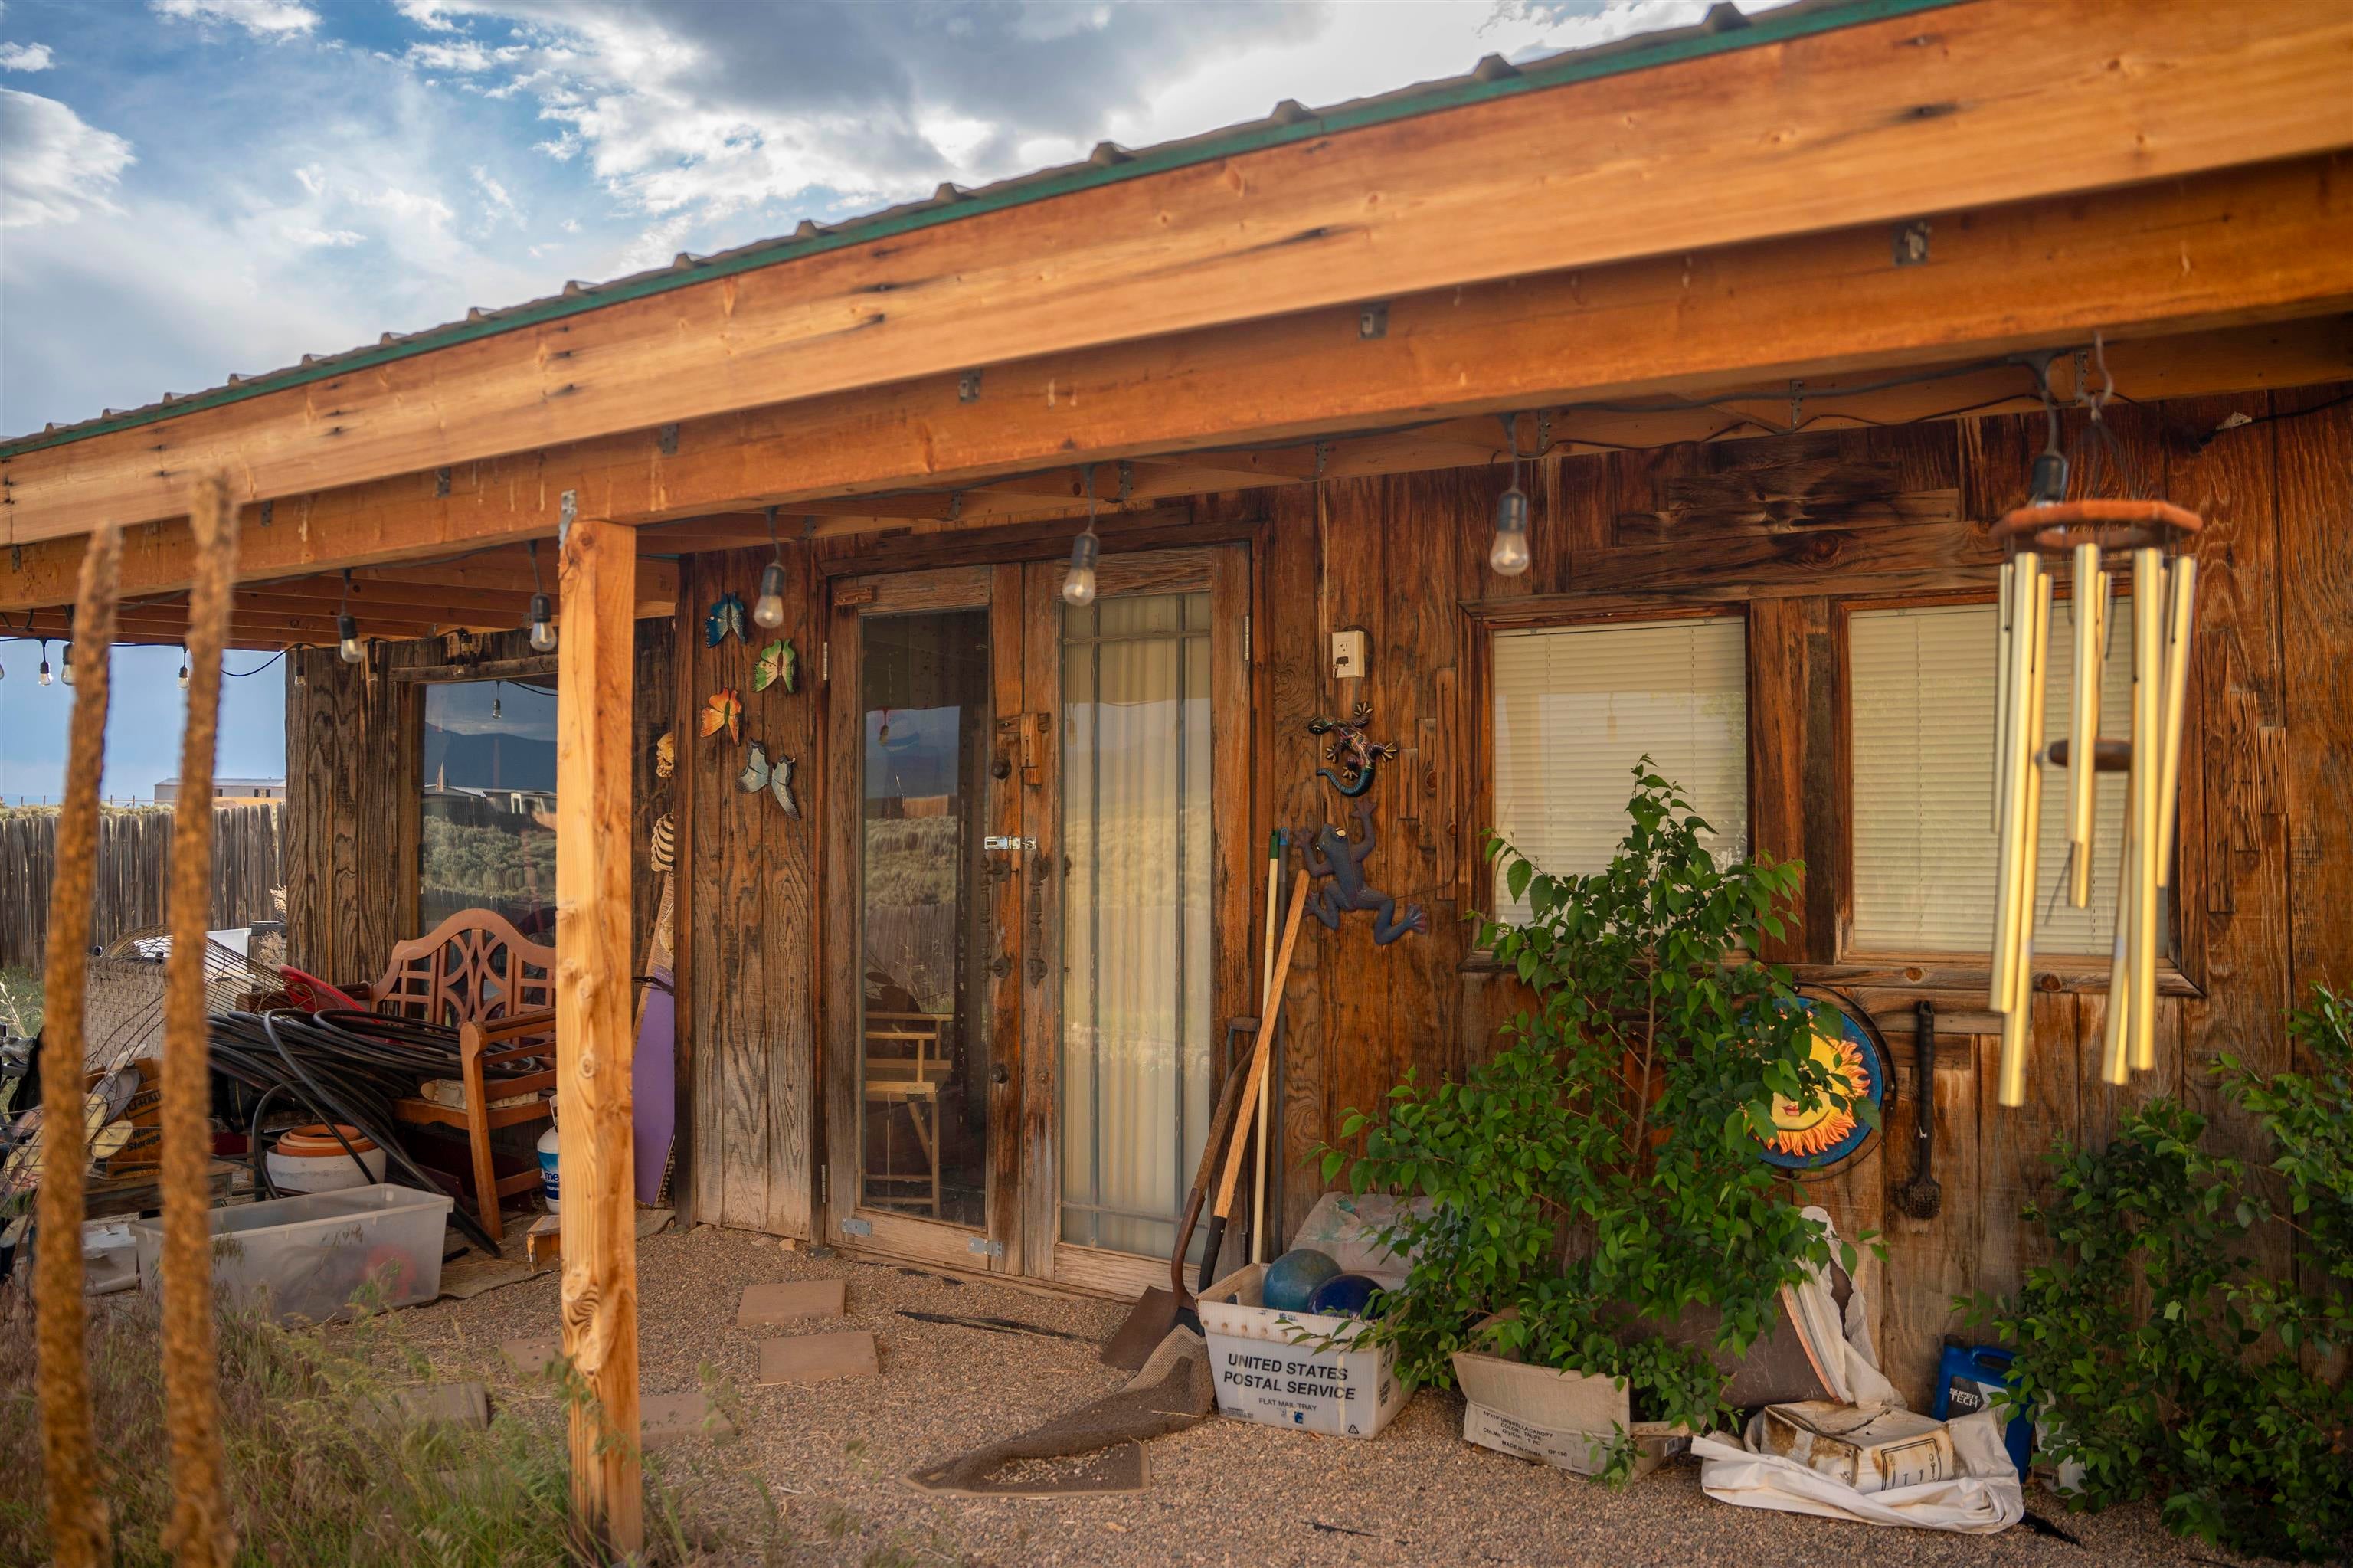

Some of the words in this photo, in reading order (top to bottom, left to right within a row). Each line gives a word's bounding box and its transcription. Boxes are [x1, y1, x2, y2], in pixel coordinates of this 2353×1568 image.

[1228, 1353, 1282, 1373] UNITED
[1286, 1362, 1348, 1381] STATES
[1223, 1370, 1281, 1392] POSTAL
[1286, 1380, 1356, 1400] SERVICE
[1949, 1387, 1978, 1399] SUPER
[1258, 1397, 1276, 1406] FLAT
[1278, 1400, 1294, 1409] MAIL
[1297, 1403, 1317, 1412] TRAY
[1950, 1393, 1978, 1409] TECH
[1500, 1417, 1528, 1432] UMBRELLA
[1529, 1428, 1553, 1439] CANOPY
[1524, 1431, 1542, 1442] TAUPE
[1501, 1440, 1517, 1449] MADE
[1524, 1448, 1542, 1457] CHINA
